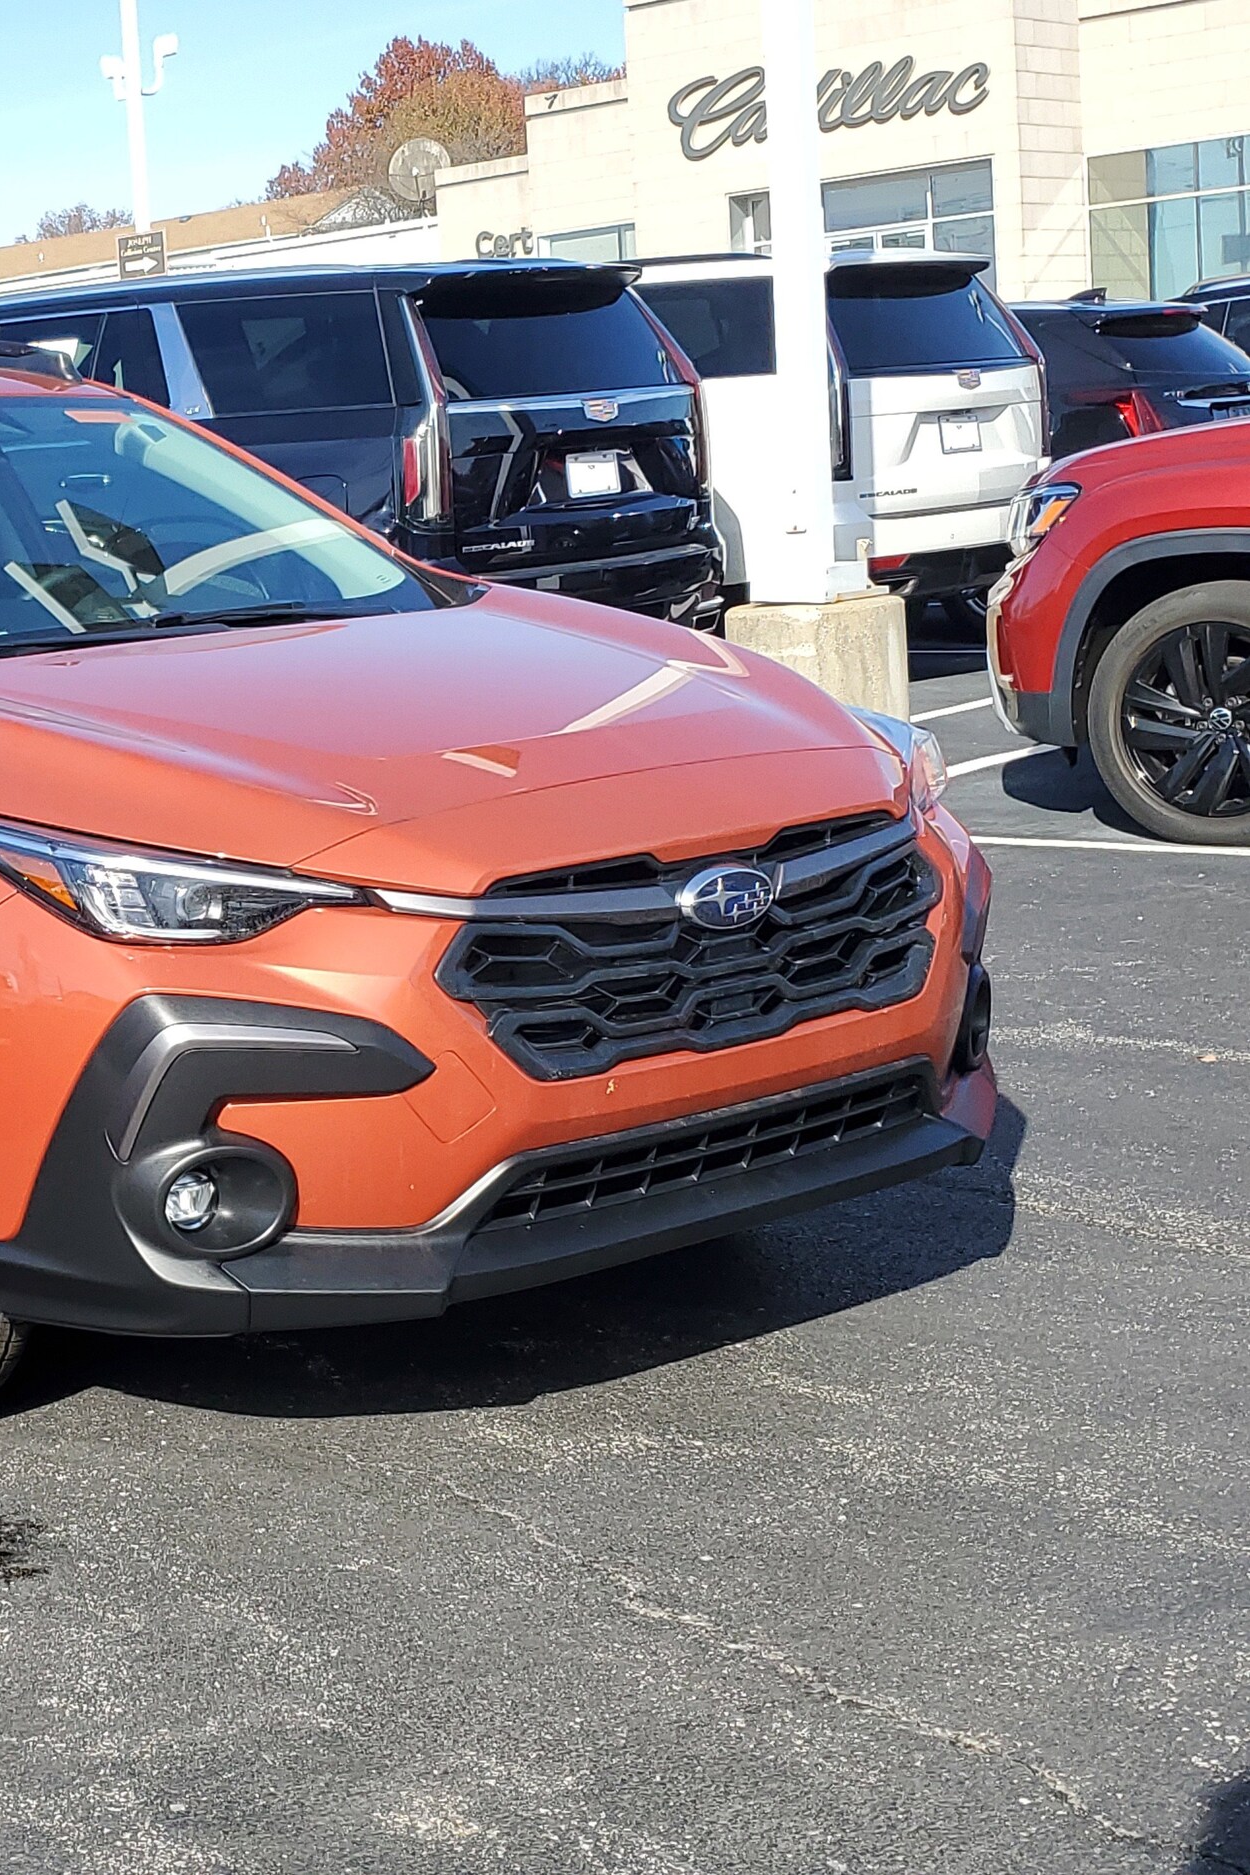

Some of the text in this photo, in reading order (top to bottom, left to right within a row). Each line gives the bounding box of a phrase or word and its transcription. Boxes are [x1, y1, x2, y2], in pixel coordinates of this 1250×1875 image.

[668, 55, 990, 162] Caillac
[475, 226, 534, 258] Cert
[859, 487, 918, 499] ESCALADE
[462, 539, 536, 554] ESCALADE
